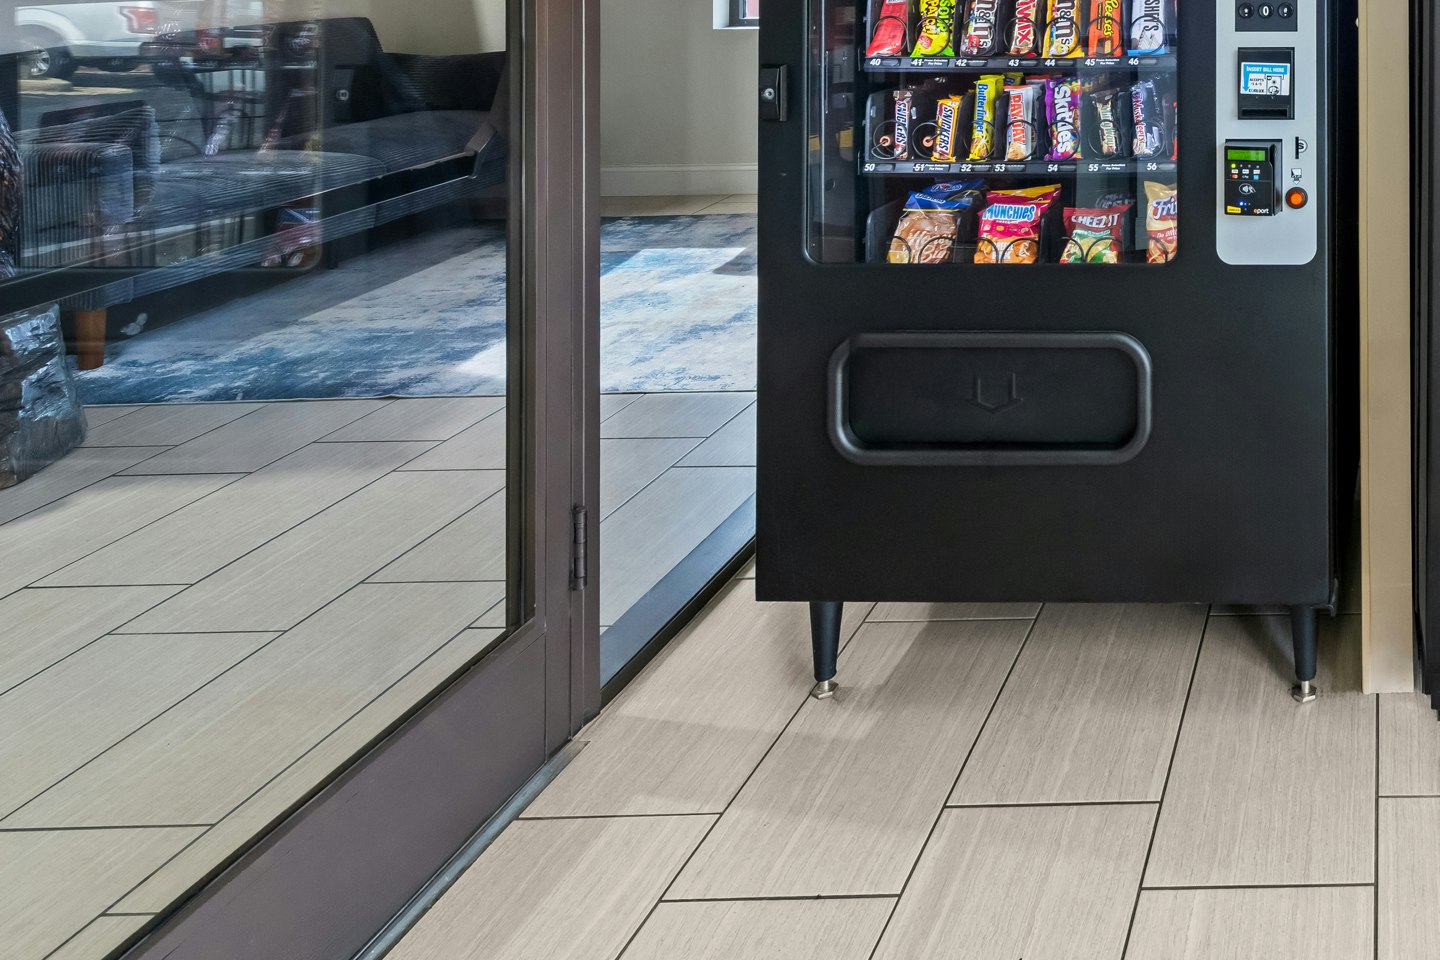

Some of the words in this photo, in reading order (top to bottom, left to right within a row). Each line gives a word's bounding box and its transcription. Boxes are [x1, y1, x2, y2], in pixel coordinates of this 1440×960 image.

[1262, 5, 1269, 16] 0
[870, 58, 881, 66] 40
[912, 58, 923, 67] 41
[956, 58, 967, 67] 42
[1008, 58, 1020, 67] 43
[1044, 58, 1056, 67] 44
[1084, 58, 1096, 67] 45
[1128, 57, 1139, 66] 46
[976, 83, 989, 135] Butterfinger
[895, 100, 907, 145] SNICKERS
[939, 106, 954, 152] SNICKERS
[864, 163, 875, 172] 50
[914, 164, 925, 172] 51
[961, 163, 972, 172] 52
[994, 163, 1006, 172] 53
[1047, 164, 1058, 172] 54
[1088, 163, 1099, 172] 55
[1146, 162, 1158, 171] 56
[982, 204, 1037, 221] MUNCHIES
